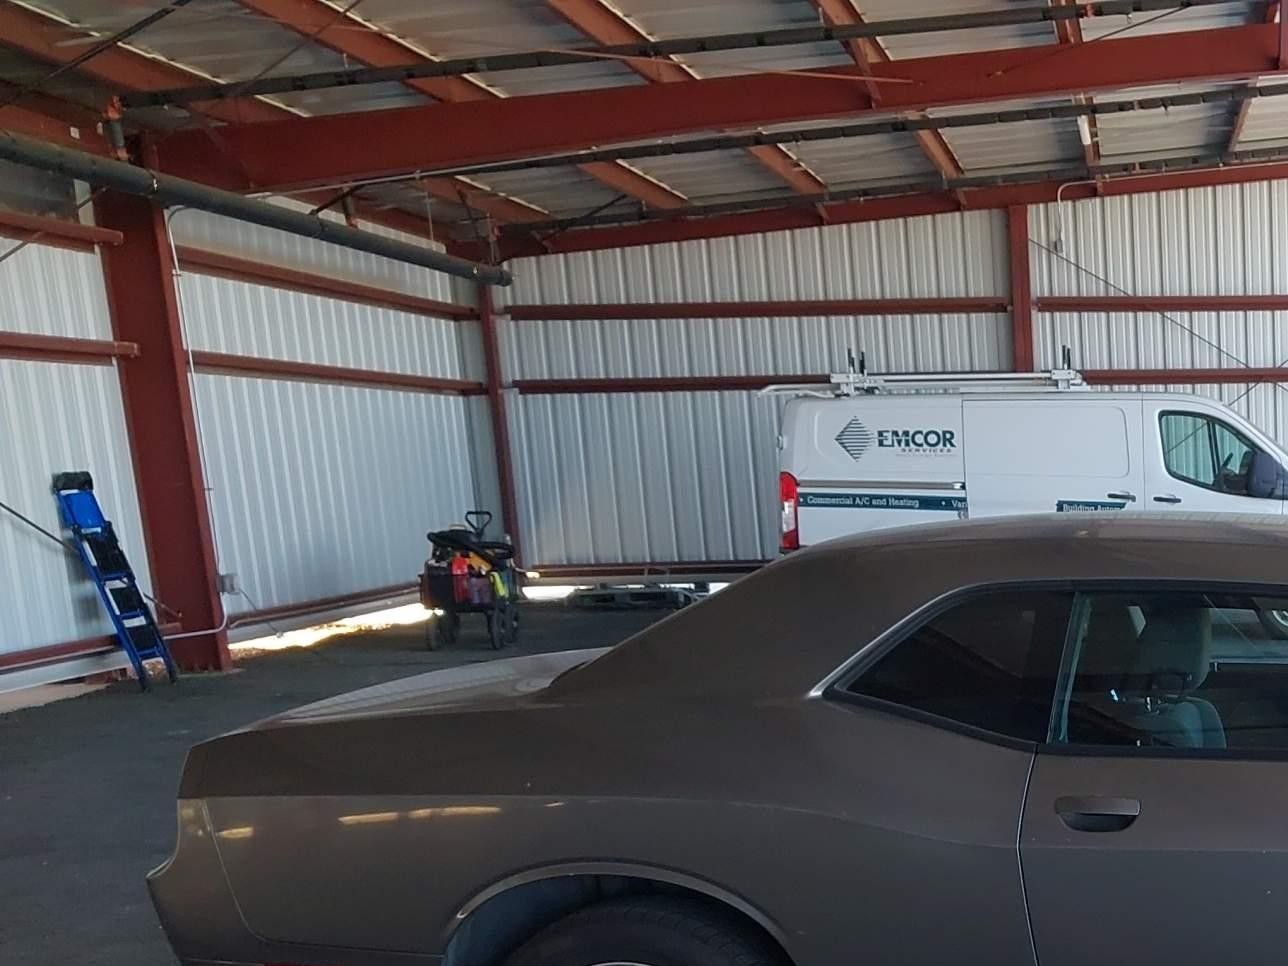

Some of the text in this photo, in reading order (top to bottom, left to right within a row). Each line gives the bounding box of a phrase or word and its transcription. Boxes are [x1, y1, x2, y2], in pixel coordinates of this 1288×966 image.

[877, 429, 957, 448] EMCOR
[807, 496, 920, 509] Commercial A/C and Heating
